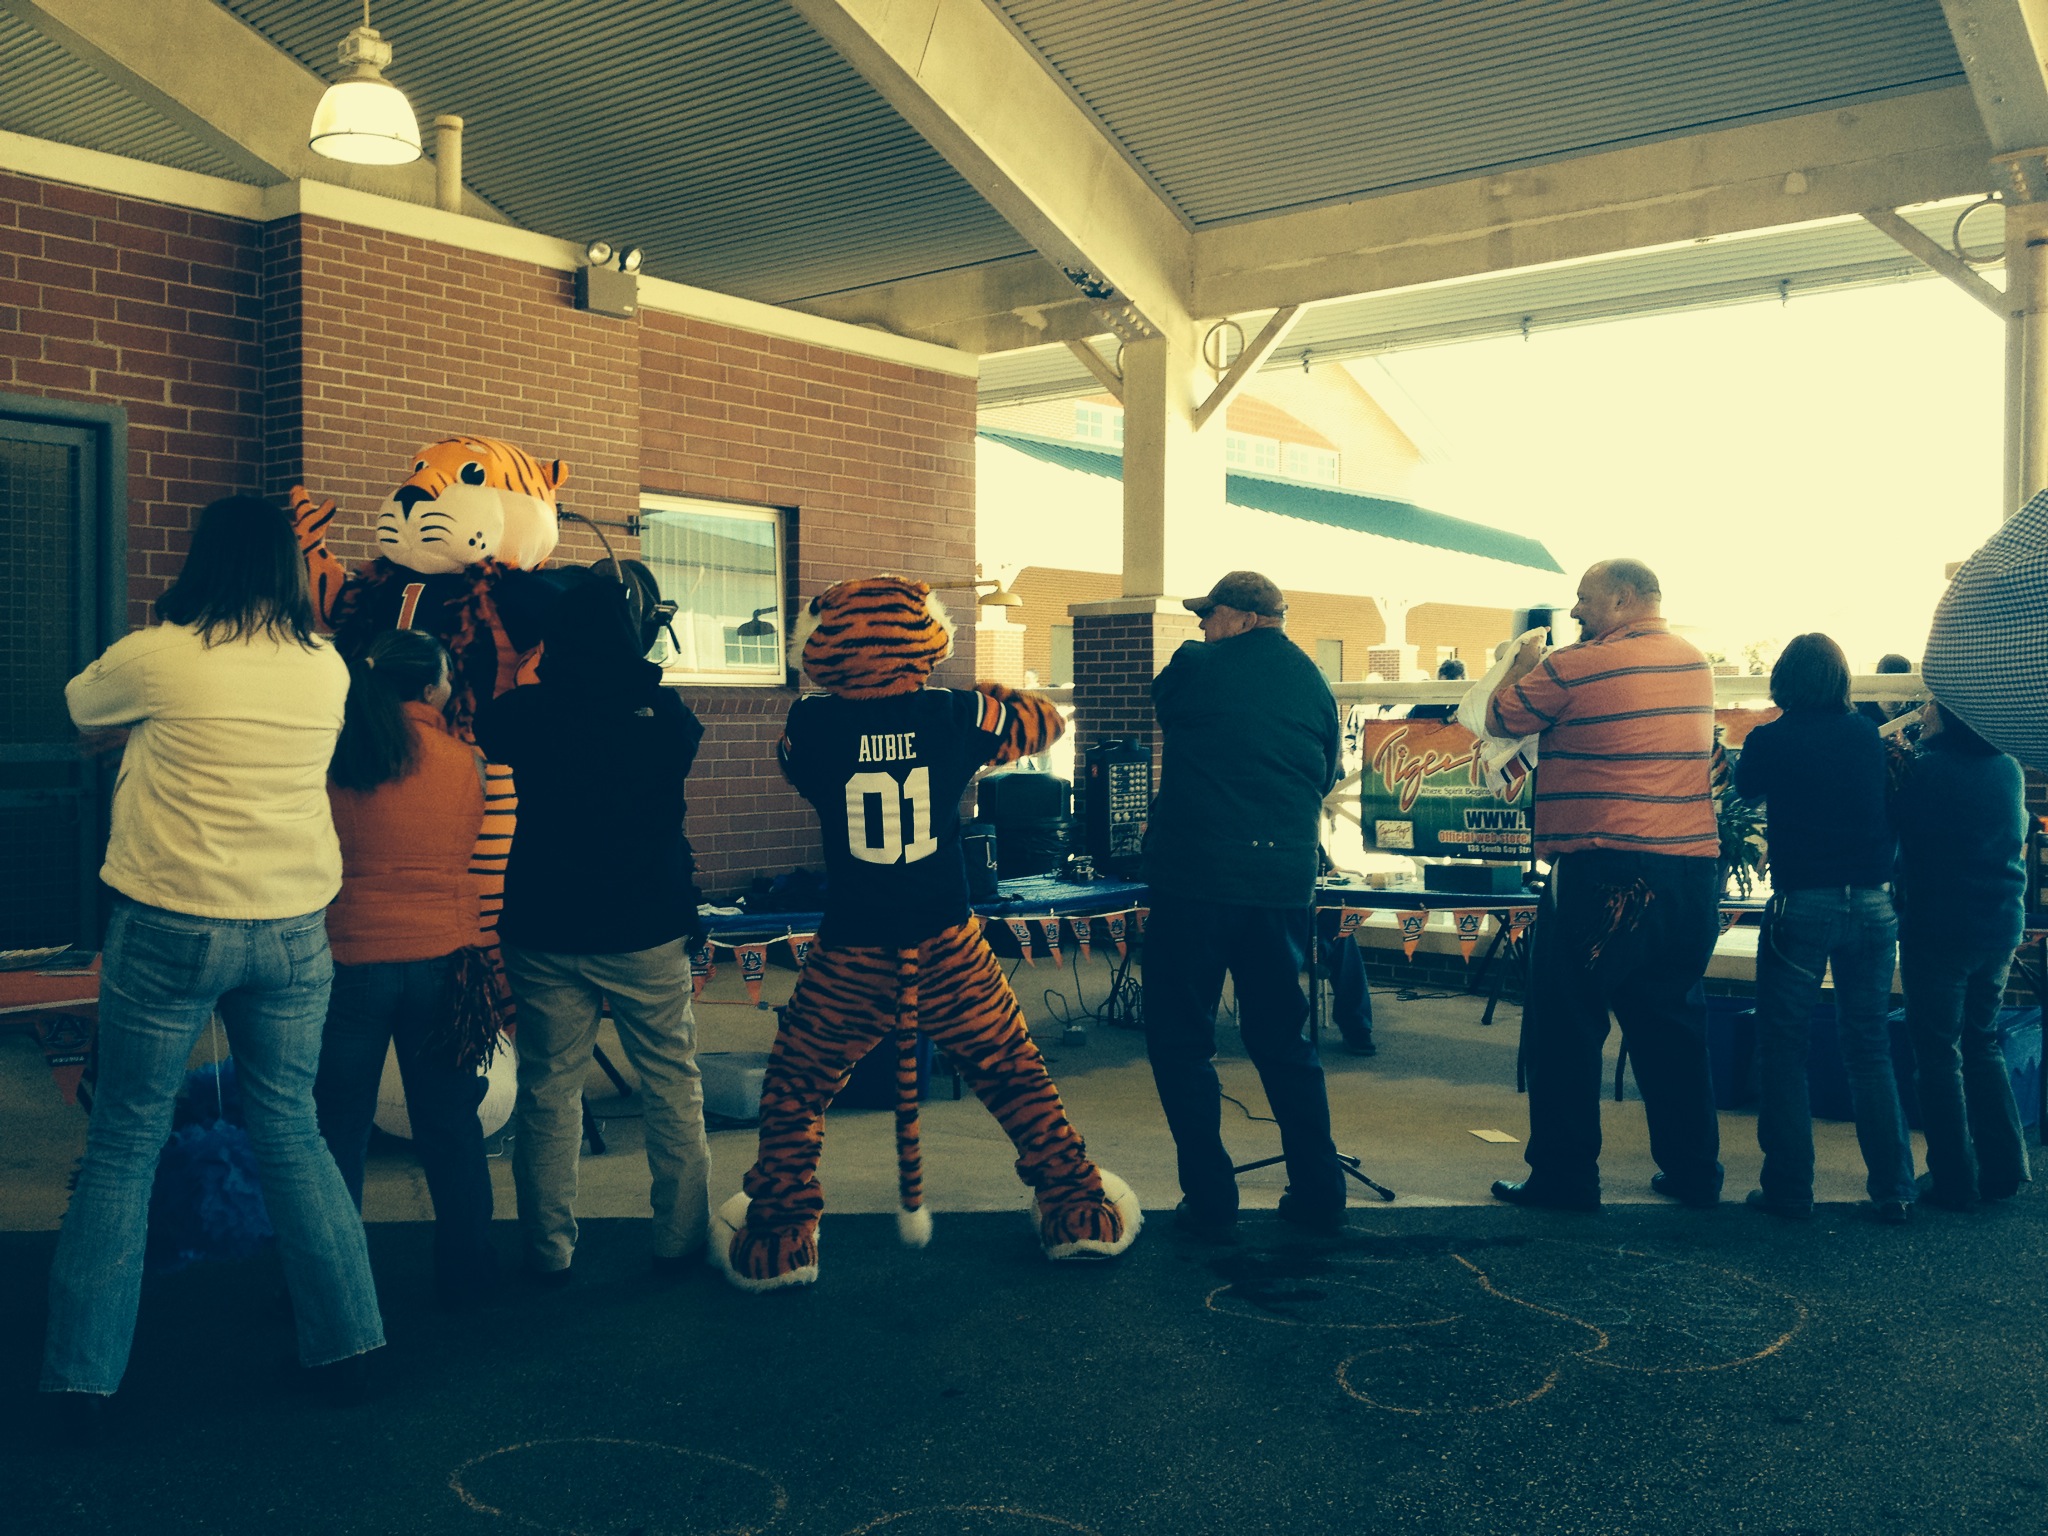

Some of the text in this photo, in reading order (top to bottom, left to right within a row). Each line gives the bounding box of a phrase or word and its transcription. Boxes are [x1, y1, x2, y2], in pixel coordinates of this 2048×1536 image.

[396, 583, 426, 630] 1
[858, 732, 917, 762] AUBIE
[1373, 726, 1472, 812] Tiger
[1444, 787, 1463, 796] Spirit
[845, 766, 938, 864] 01
[1439, 830, 1474, 843] Official
